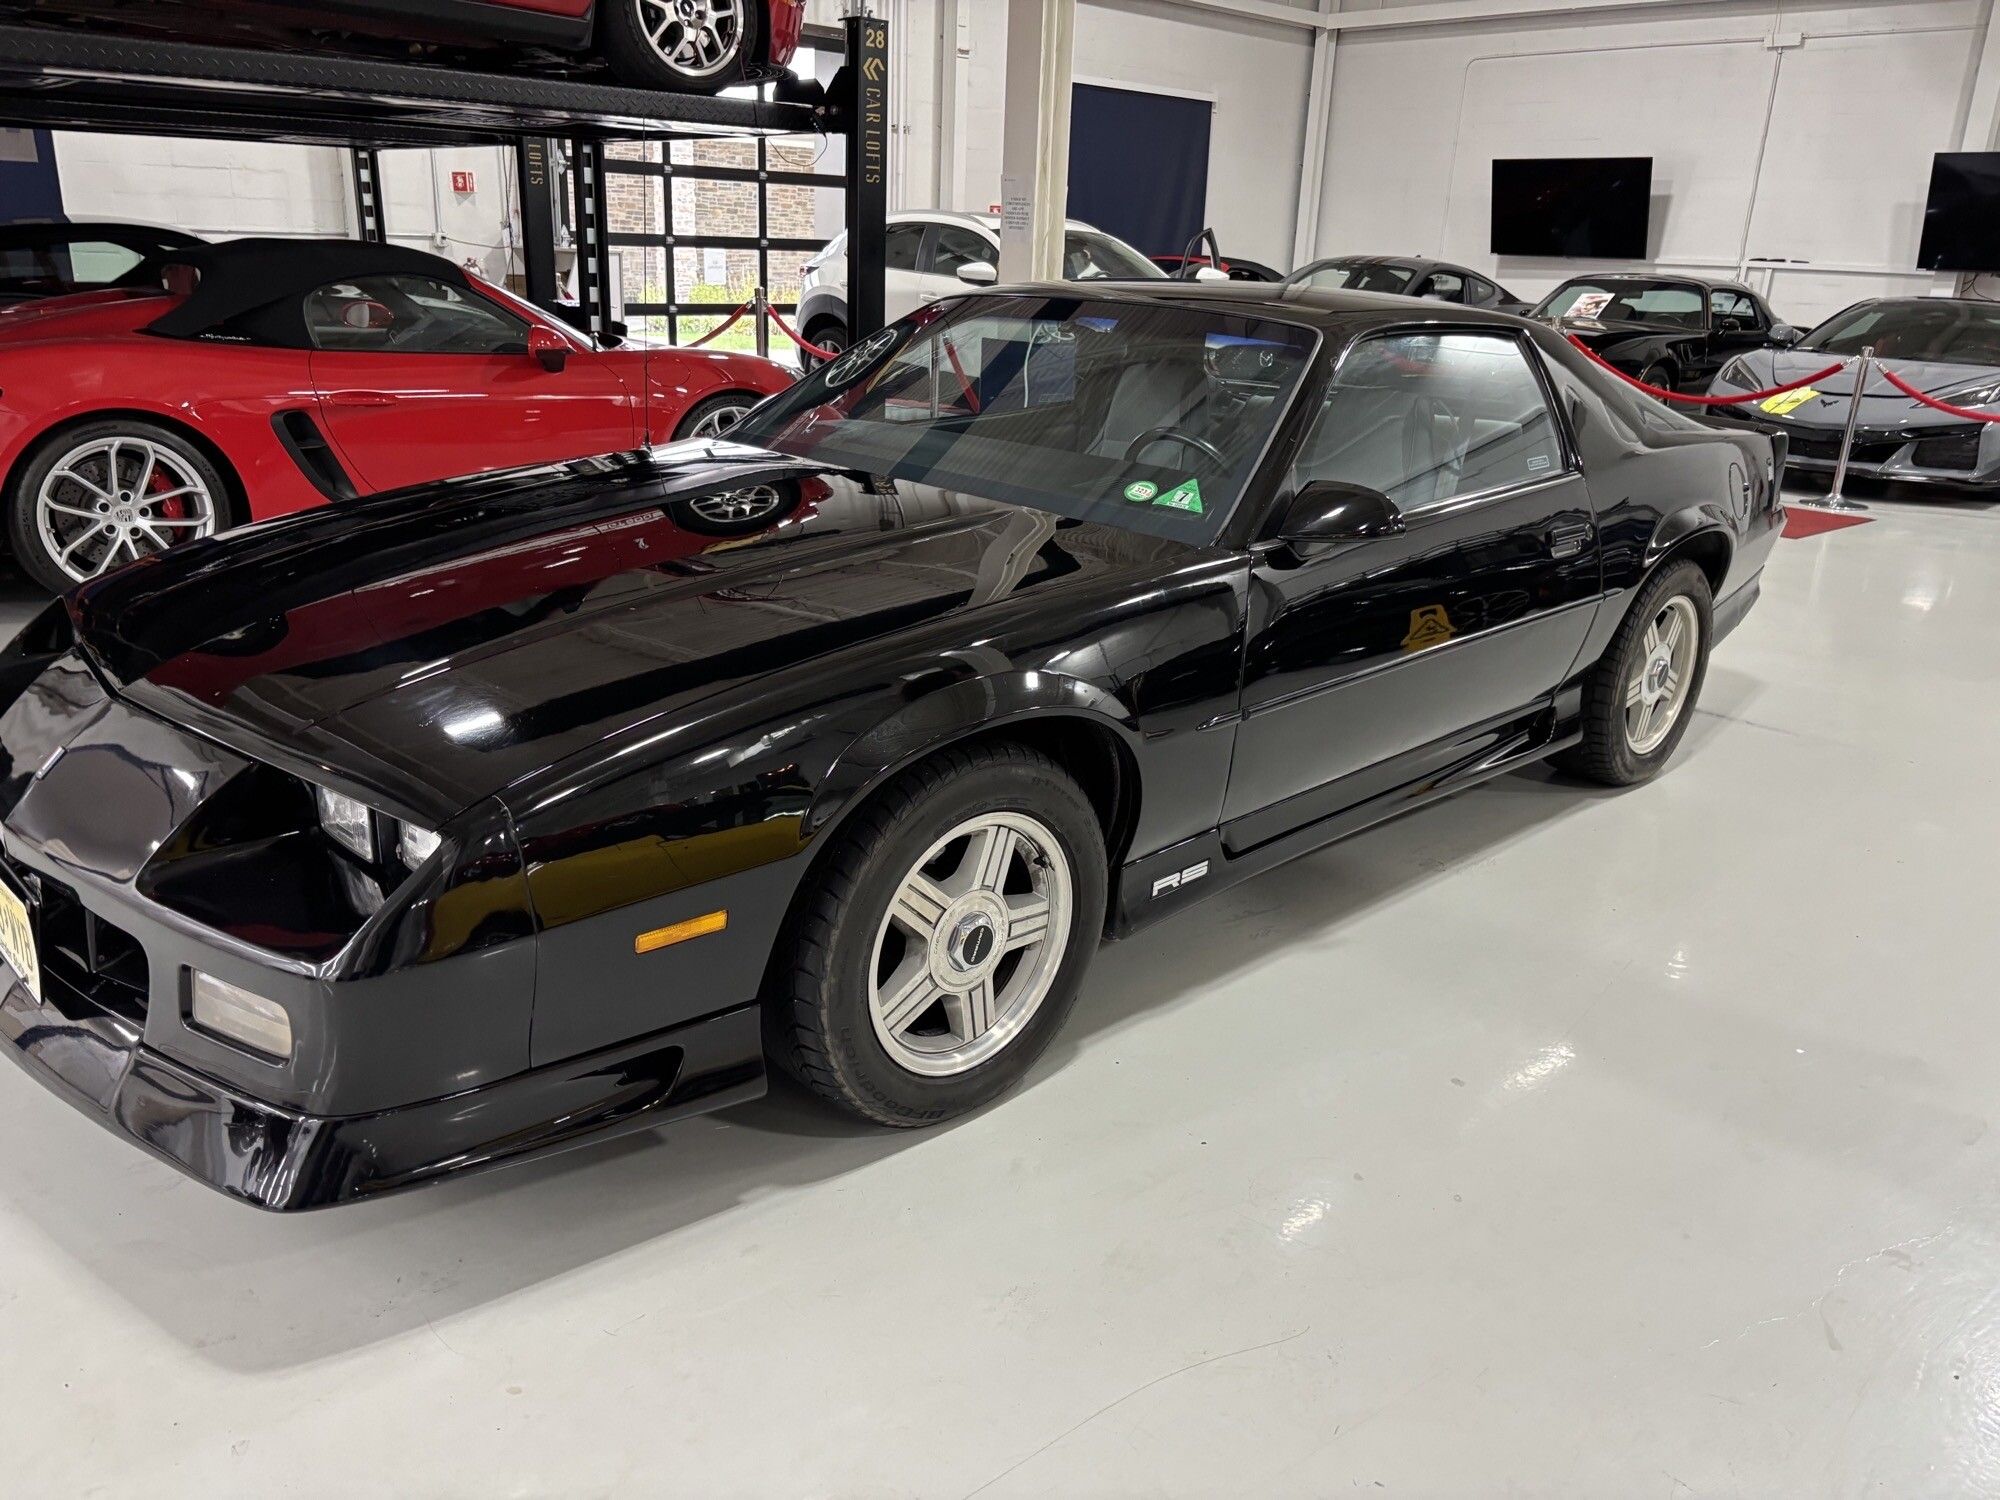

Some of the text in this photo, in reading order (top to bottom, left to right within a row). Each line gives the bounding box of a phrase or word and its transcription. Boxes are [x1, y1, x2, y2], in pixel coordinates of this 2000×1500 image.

[866, 29, 885, 49] 28
[865, 88, 881, 184] CAR LOFTS
[1179, 492, 1190, 502] 7
[1152, 860, 1209, 897] RS
